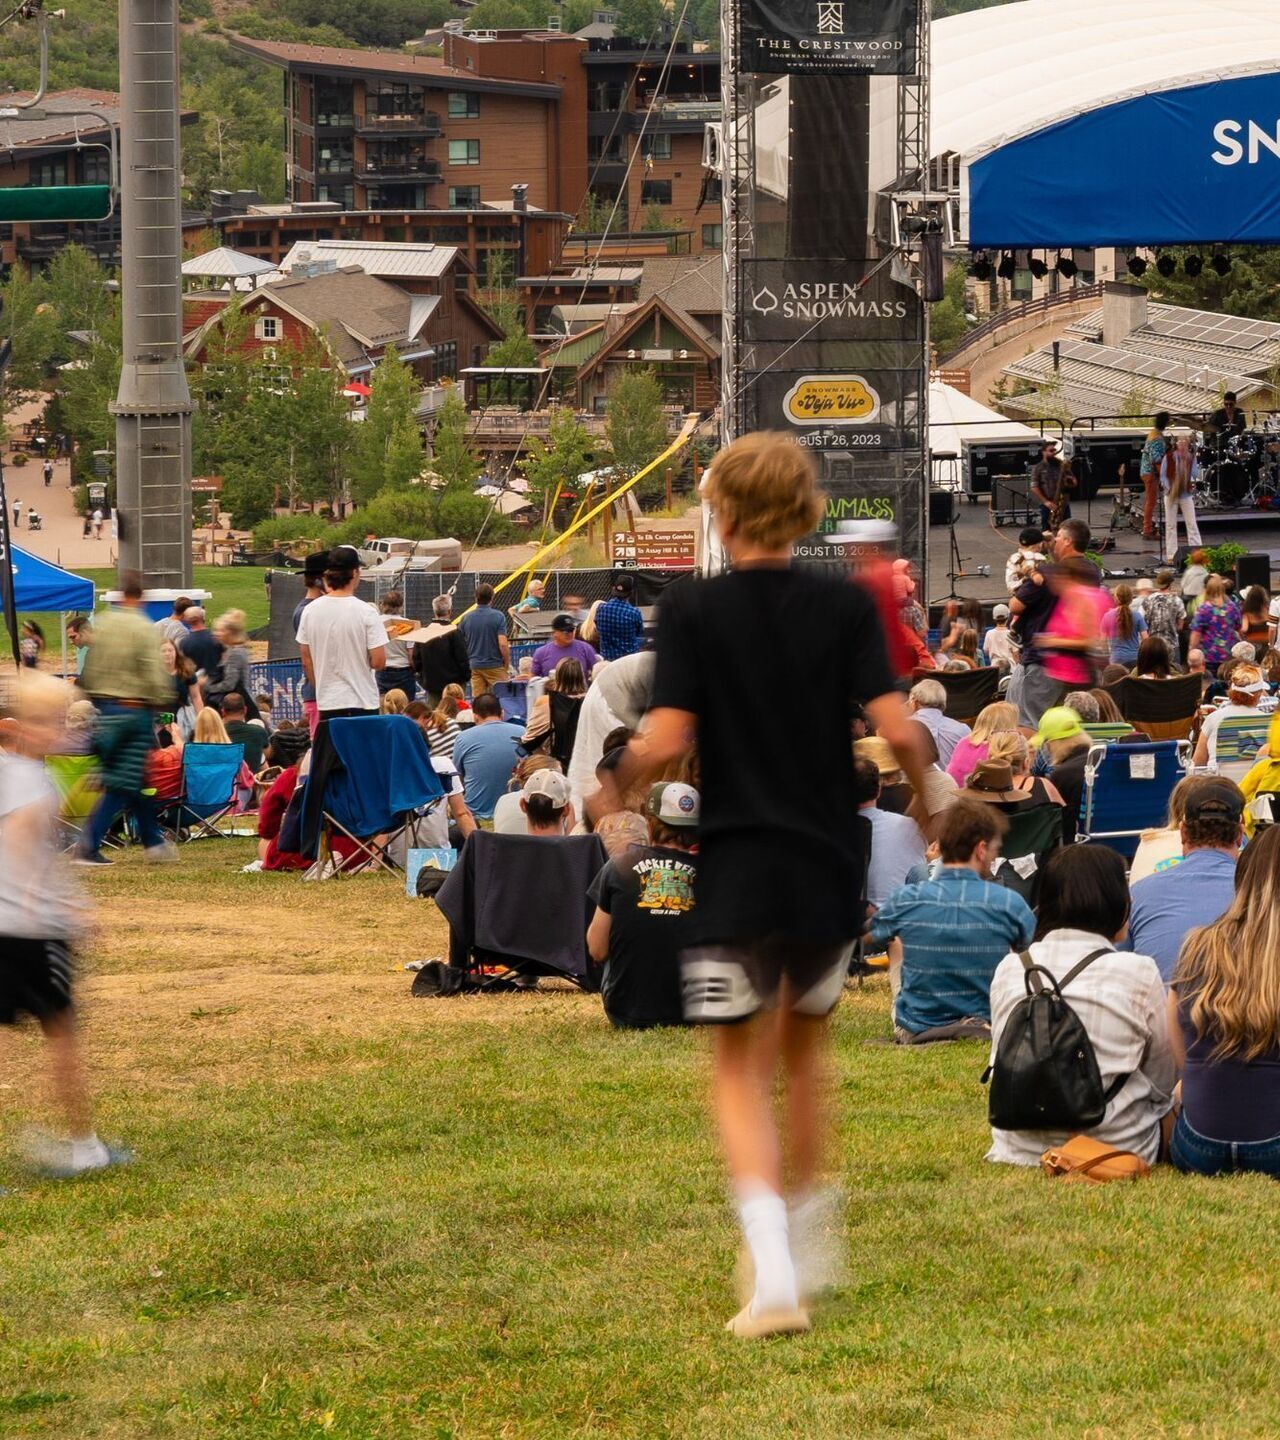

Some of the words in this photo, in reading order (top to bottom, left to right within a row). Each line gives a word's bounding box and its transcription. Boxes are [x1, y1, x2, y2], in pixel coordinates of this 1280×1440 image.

[756, 38, 791, 49] THE
[798, 39, 903, 51] CRESTWOOD
[783, 283, 857, 300] ASPEN
[782, 301, 907, 318] SNOWMASS
[627, 349, 636, 358] 2
[679, 349, 688, 358] 2
[832, 435, 850, 447] 26,
[852, 434, 881, 445] 2023
[833, 545, 847, 558] 19,
[850, 546, 879, 556] 203
[632, 858, 673, 874] TACKLE
